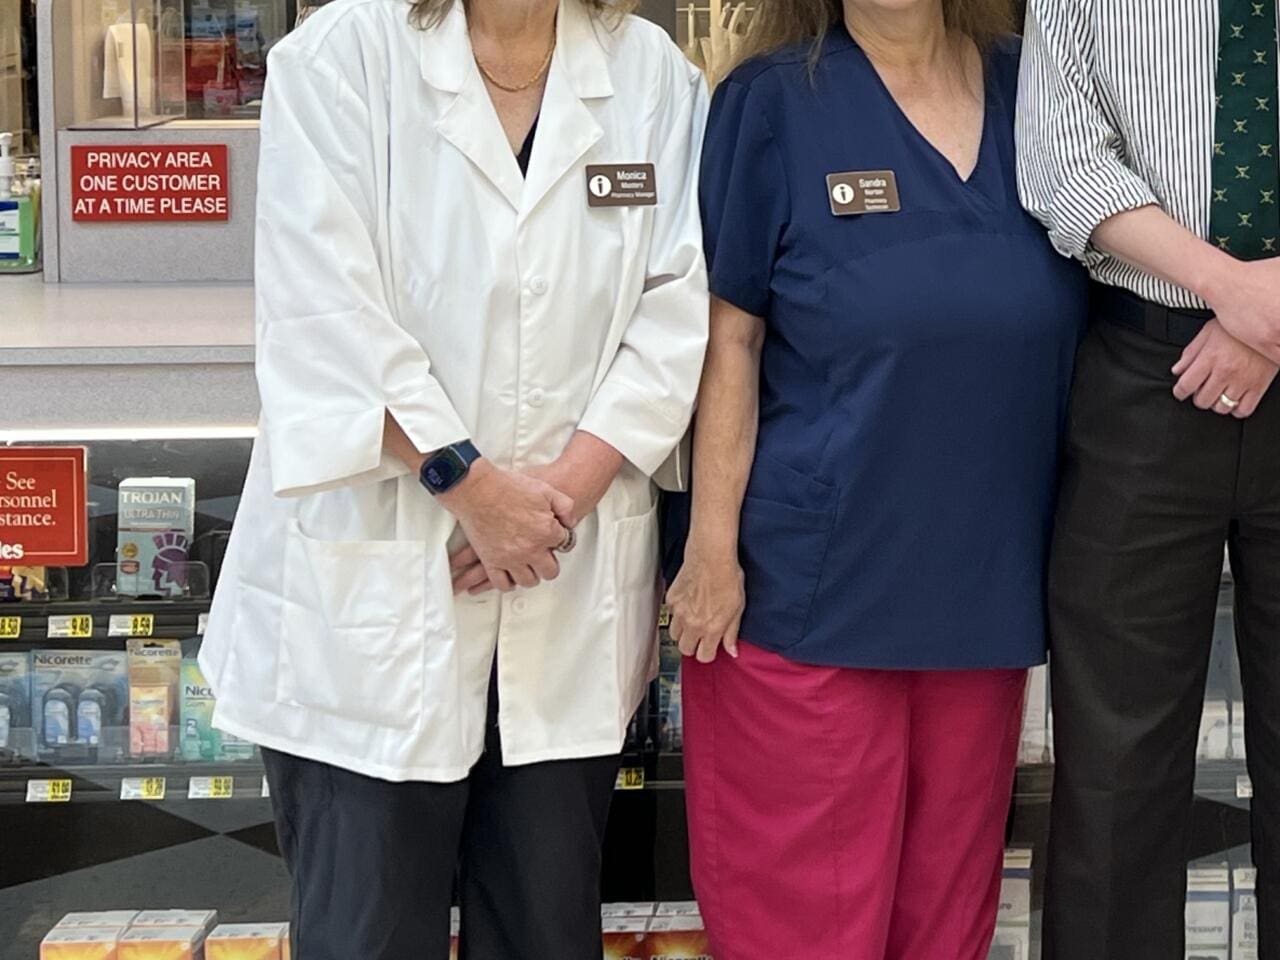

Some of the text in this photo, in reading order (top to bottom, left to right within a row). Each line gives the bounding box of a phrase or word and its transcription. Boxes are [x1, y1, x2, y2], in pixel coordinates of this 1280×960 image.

[87, 152, 212, 168] PRIVACY AREA
[80, 174, 220, 191] ONE CUSTOMER
[74, 197, 227, 214] AT A TIME PLEASE
[6, 471, 36, 490] See
[121, 492, 183, 504] TROJAN
[0, 513, 56, 527] stance.
[33, 654, 92, 665] Nicorette
